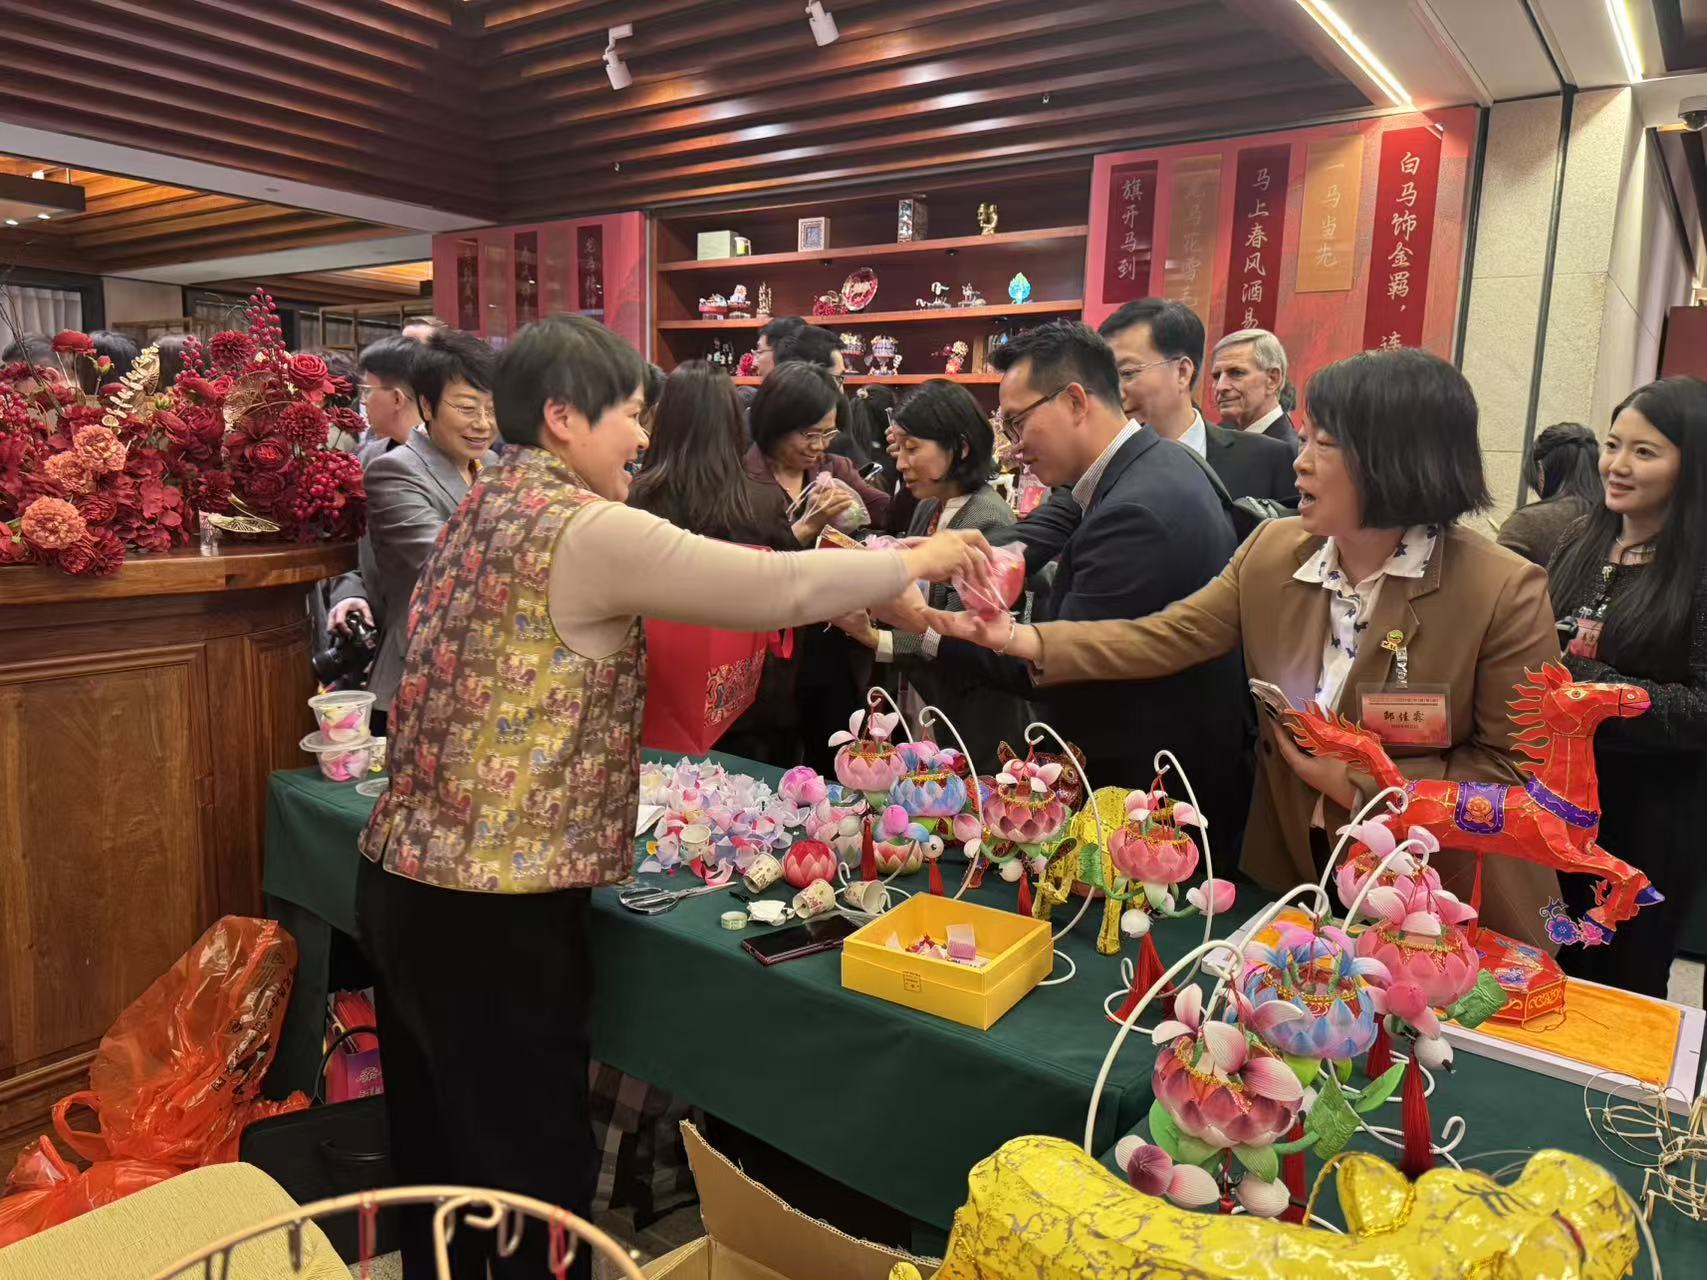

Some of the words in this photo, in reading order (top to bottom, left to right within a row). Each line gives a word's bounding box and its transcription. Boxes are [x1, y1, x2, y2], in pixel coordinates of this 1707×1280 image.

[1117, 178, 1143, 280] 旗开马到
[1315, 163, 1345, 267] 一马当先
